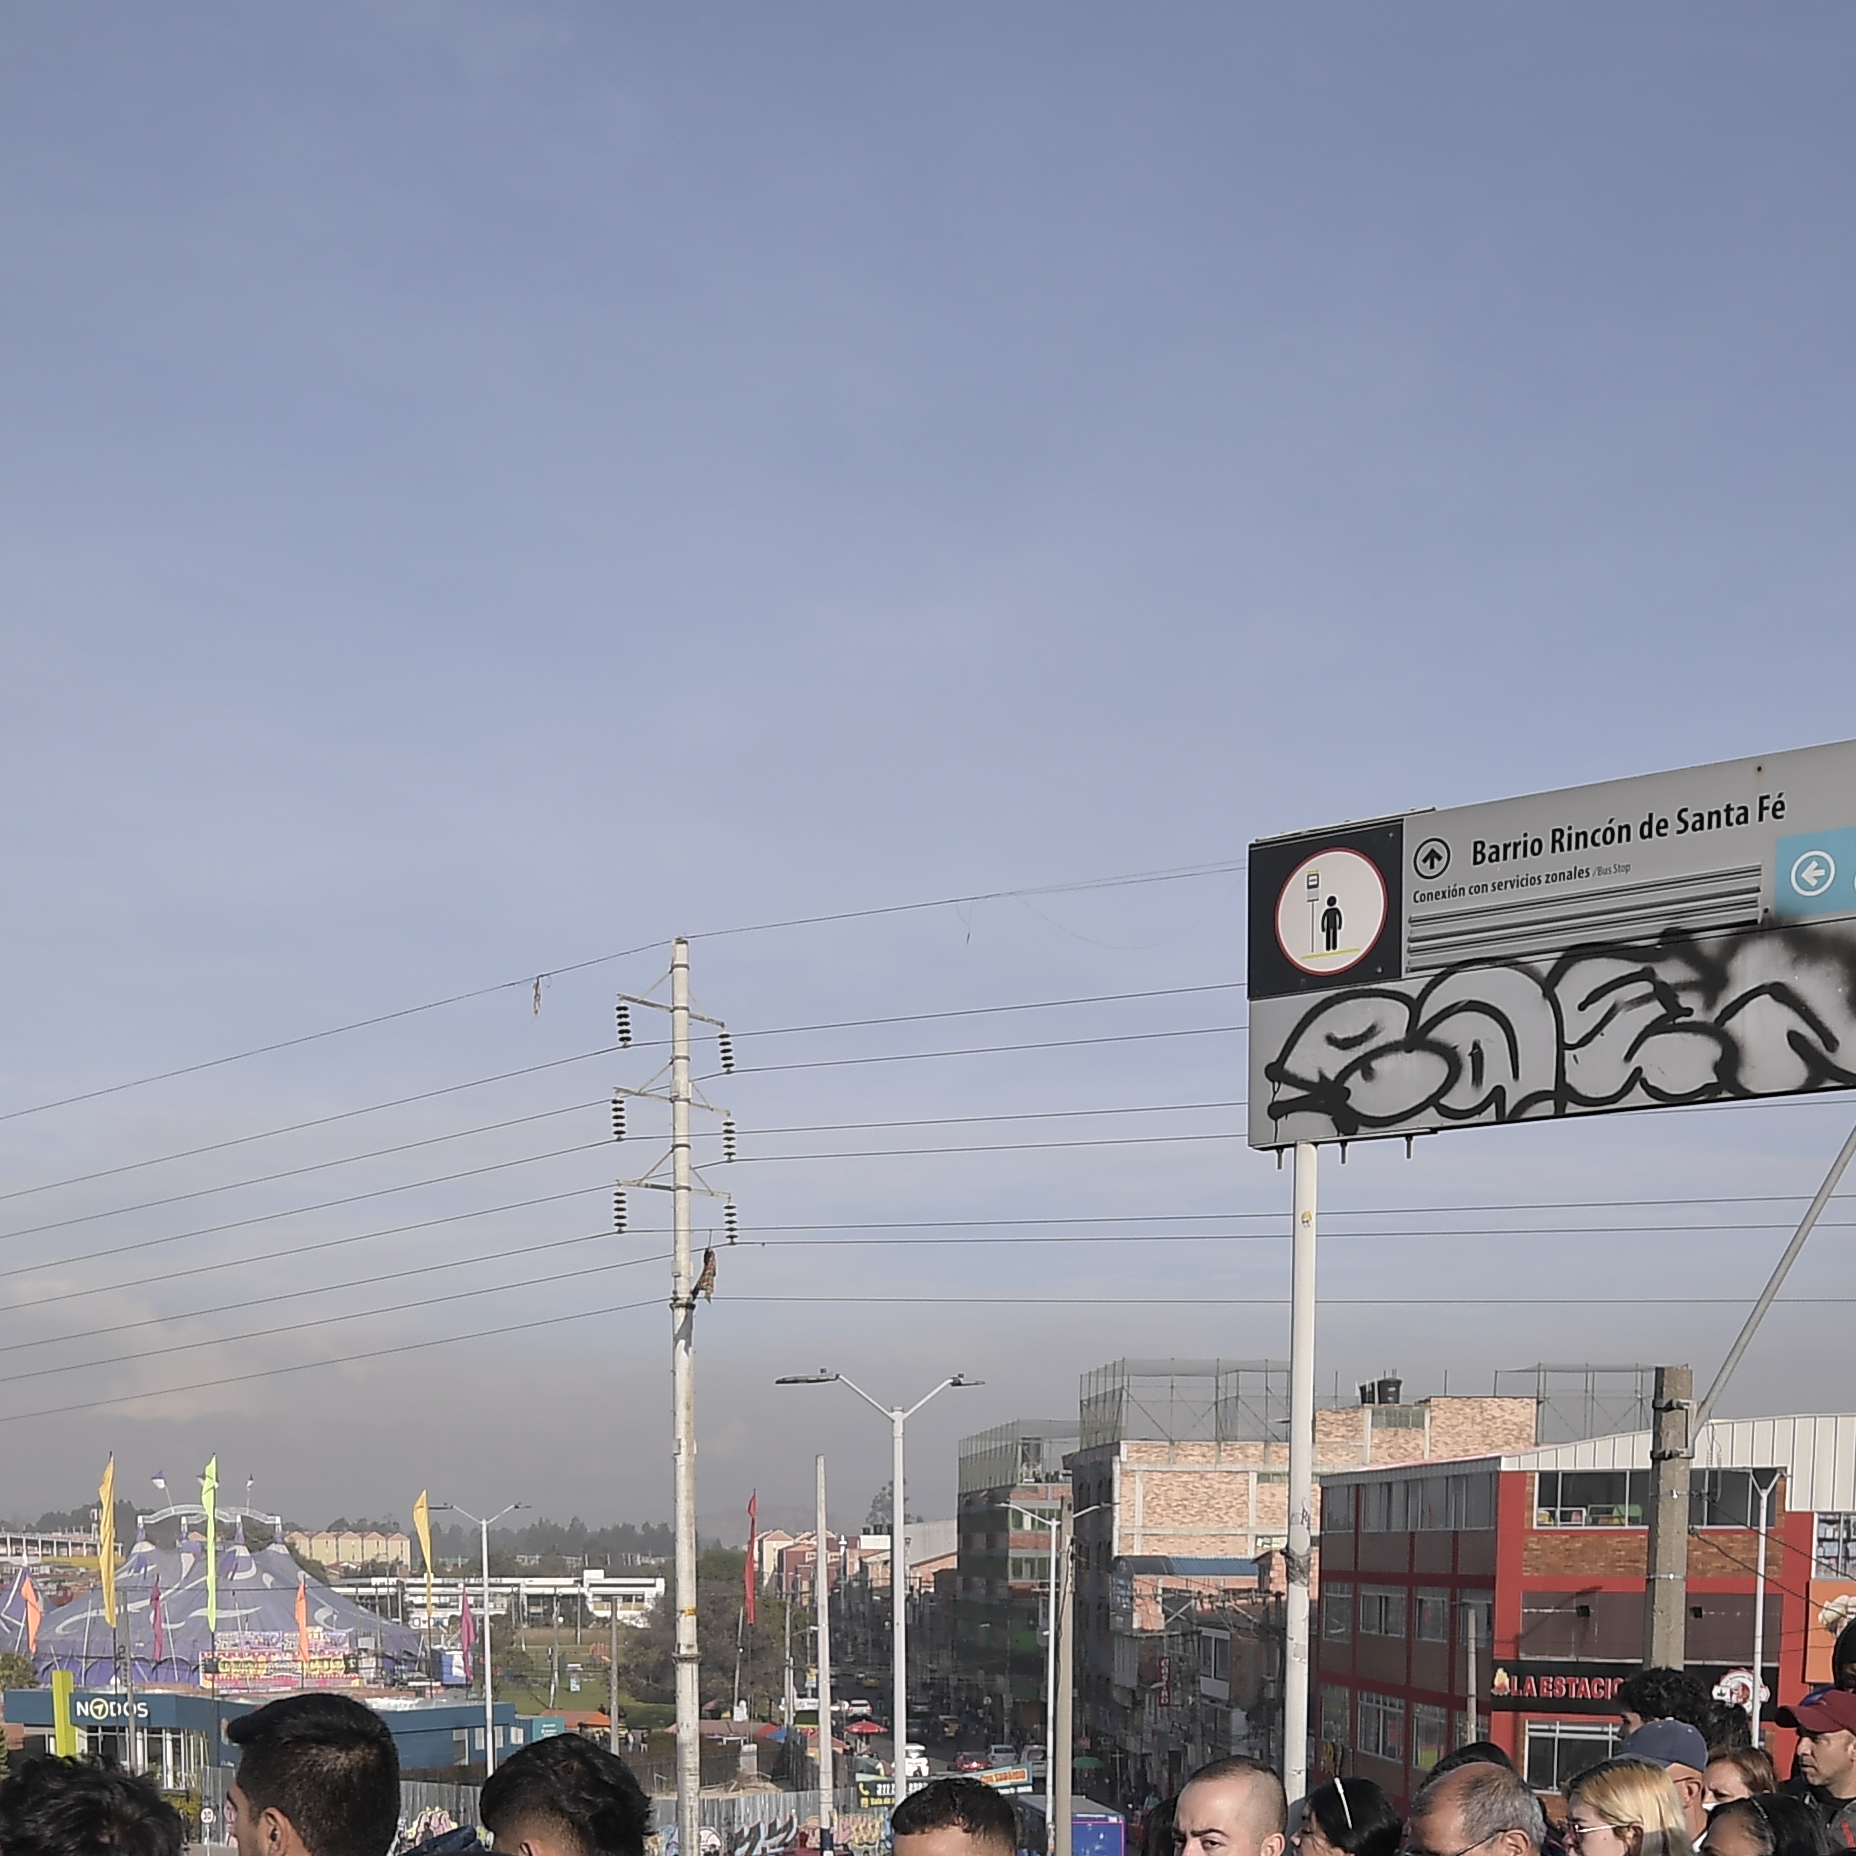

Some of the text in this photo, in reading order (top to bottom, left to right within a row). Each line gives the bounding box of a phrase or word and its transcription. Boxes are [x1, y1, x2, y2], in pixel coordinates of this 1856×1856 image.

[1471, 791, 1787, 867] Barrio Rincón de Santa Fé
[1412, 883, 1466, 905] Conexión
[1467, 882, 1490, 899] con
[1490, 872, 1543, 895] servicios
[1544, 865, 1592, 885] zonales
[1612, 861, 1632, 877] Stop
[1510, 1674, 1537, 1698] LA
